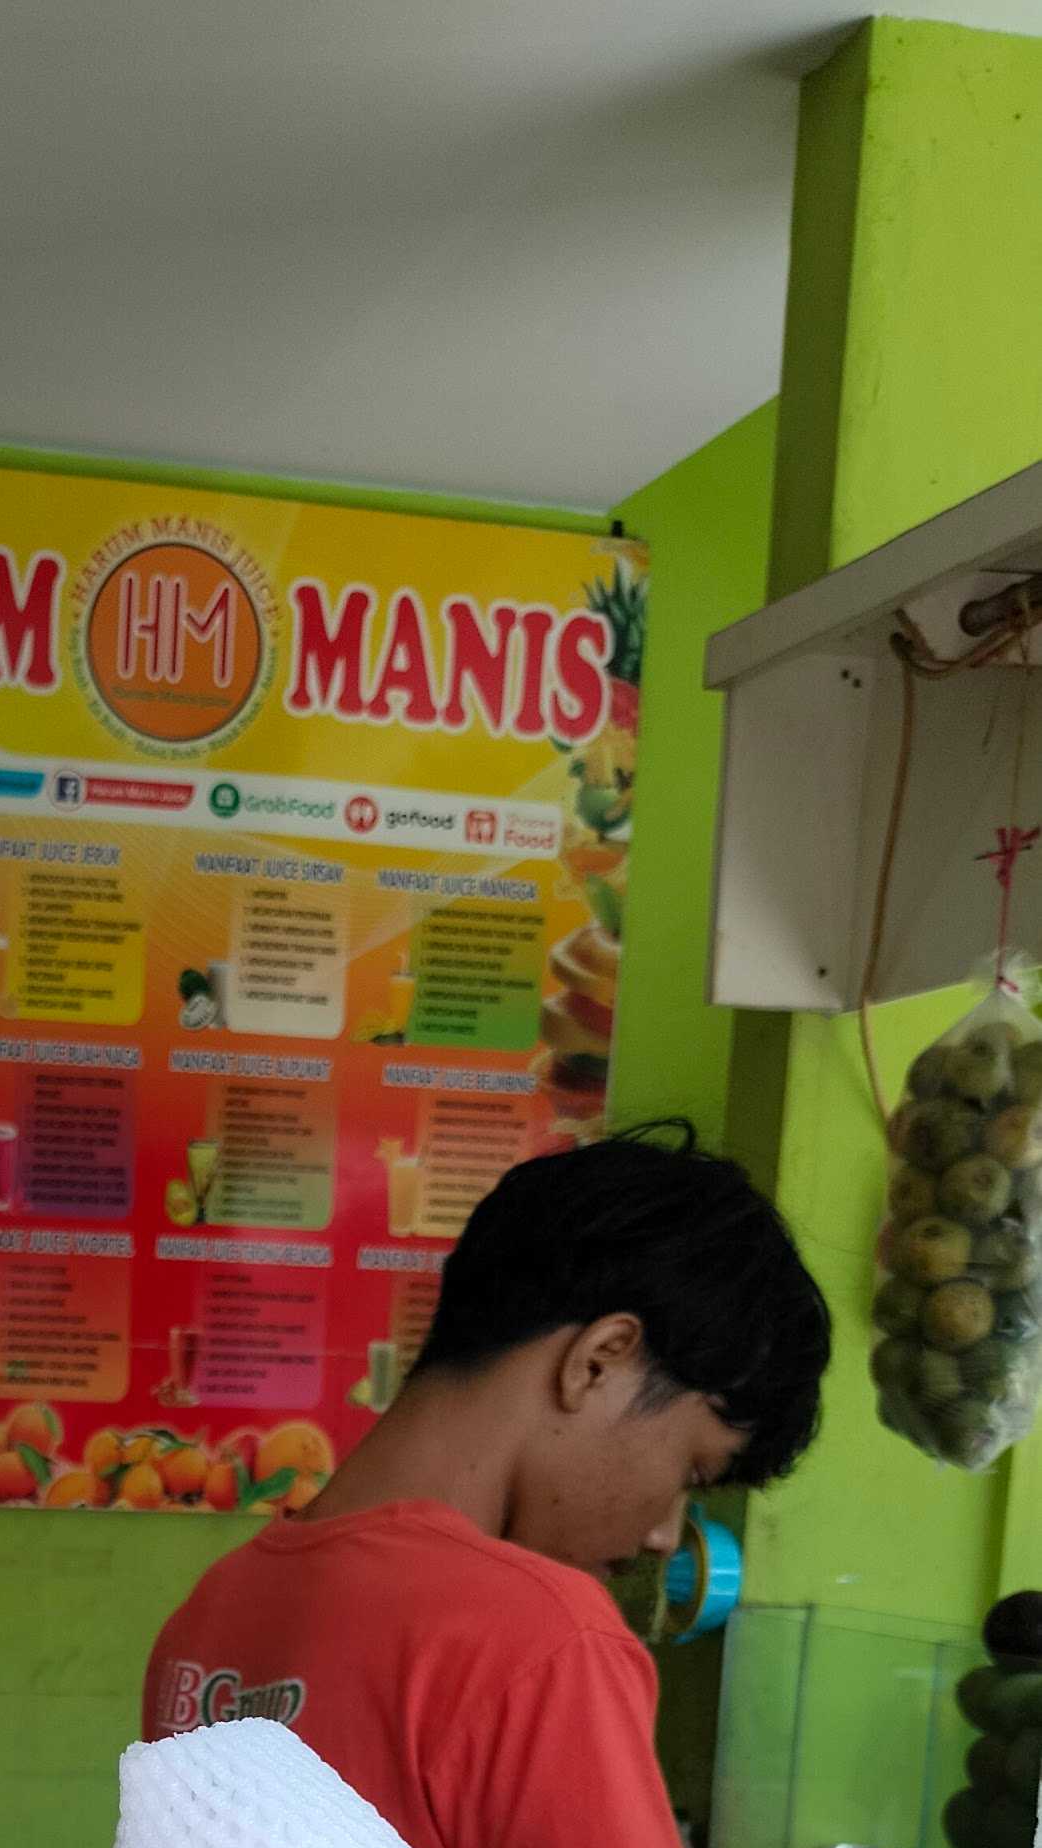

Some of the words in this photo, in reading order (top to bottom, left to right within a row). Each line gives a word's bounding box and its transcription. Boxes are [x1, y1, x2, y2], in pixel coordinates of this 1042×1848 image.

[70, 522, 142, 602] HARUM
[150, 514, 233, 550] MANIS
[118, 573, 237, 688] HM
[284, 582, 611, 744] MANIS
[244, 794, 335, 820] GrabFood
[385, 809, 455, 830] gofood
[504, 829, 555, 849] Food
